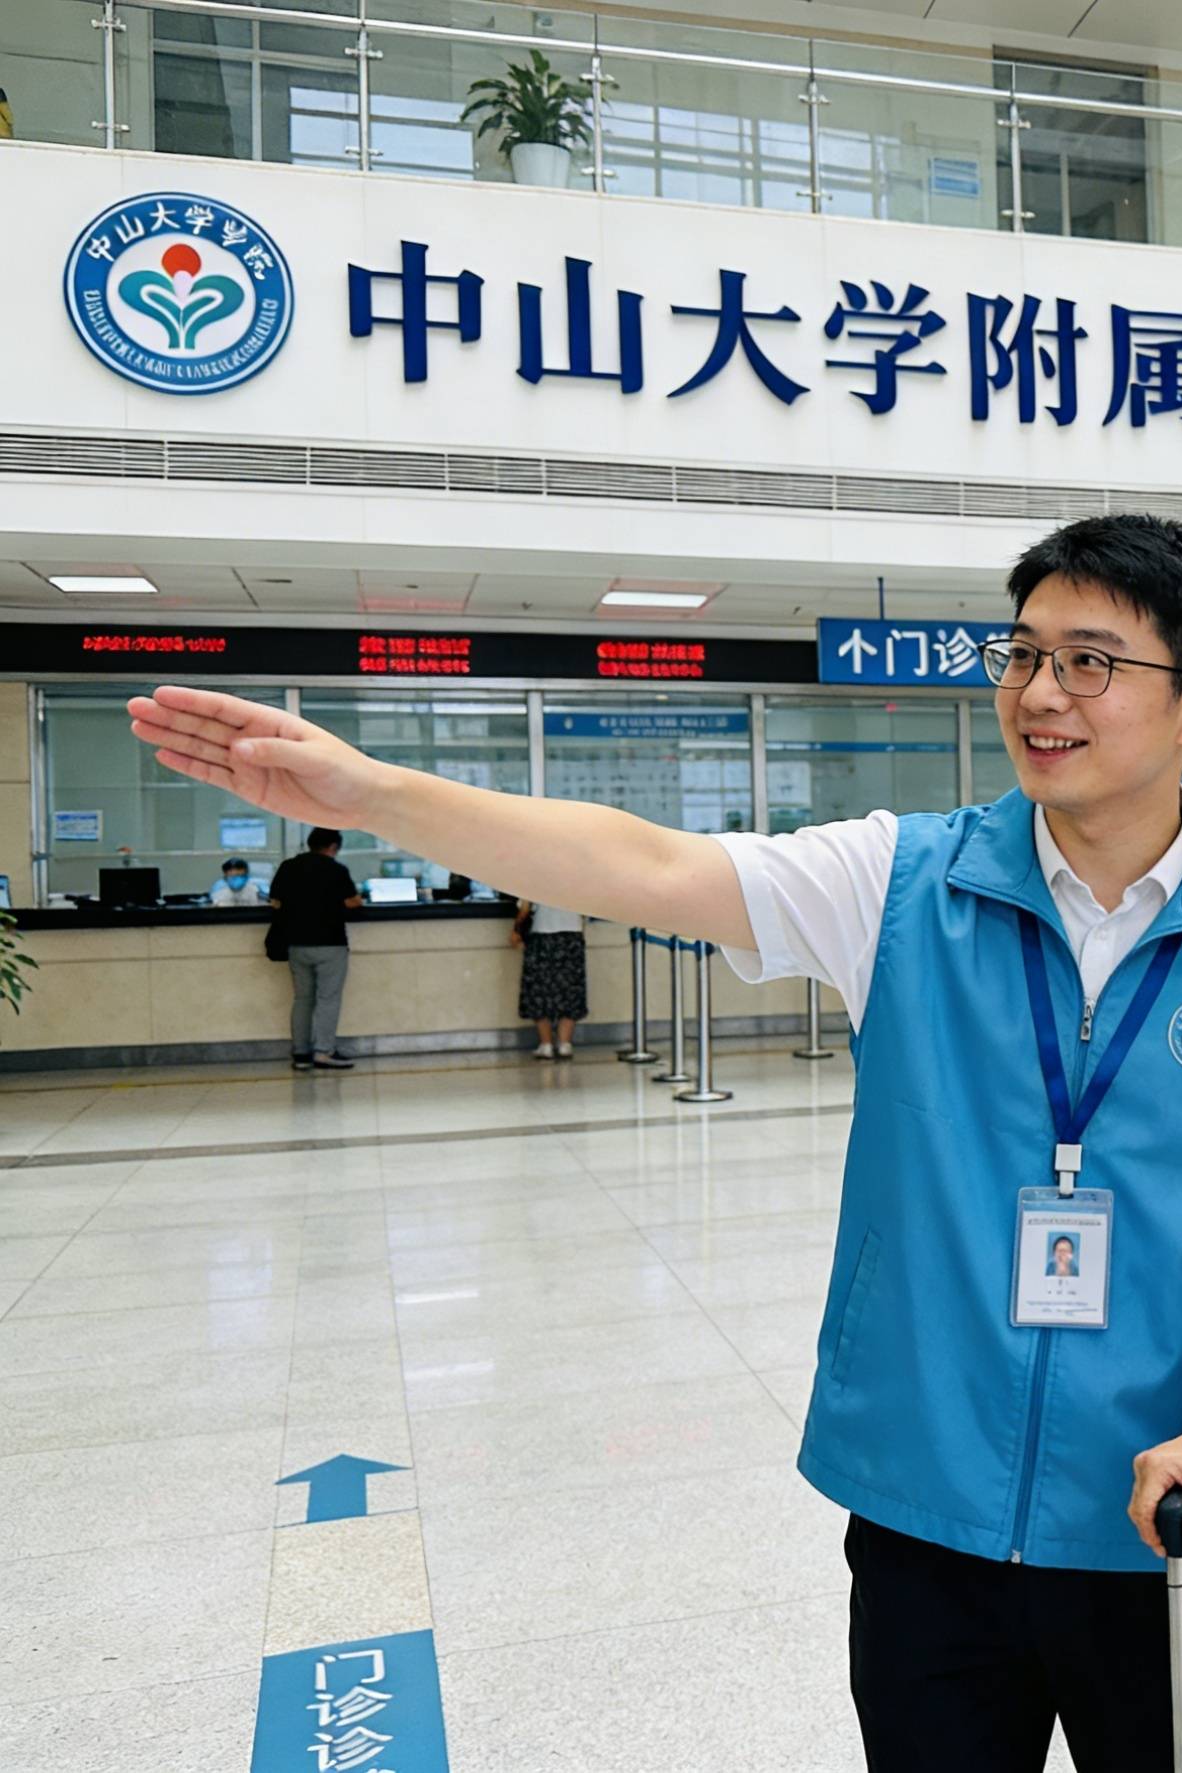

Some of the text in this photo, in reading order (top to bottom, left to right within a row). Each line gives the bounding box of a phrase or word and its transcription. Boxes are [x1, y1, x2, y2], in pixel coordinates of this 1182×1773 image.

[886, 626, 1010, 677] 门诊
[305, 1648, 397, 1773] 门诊诊
